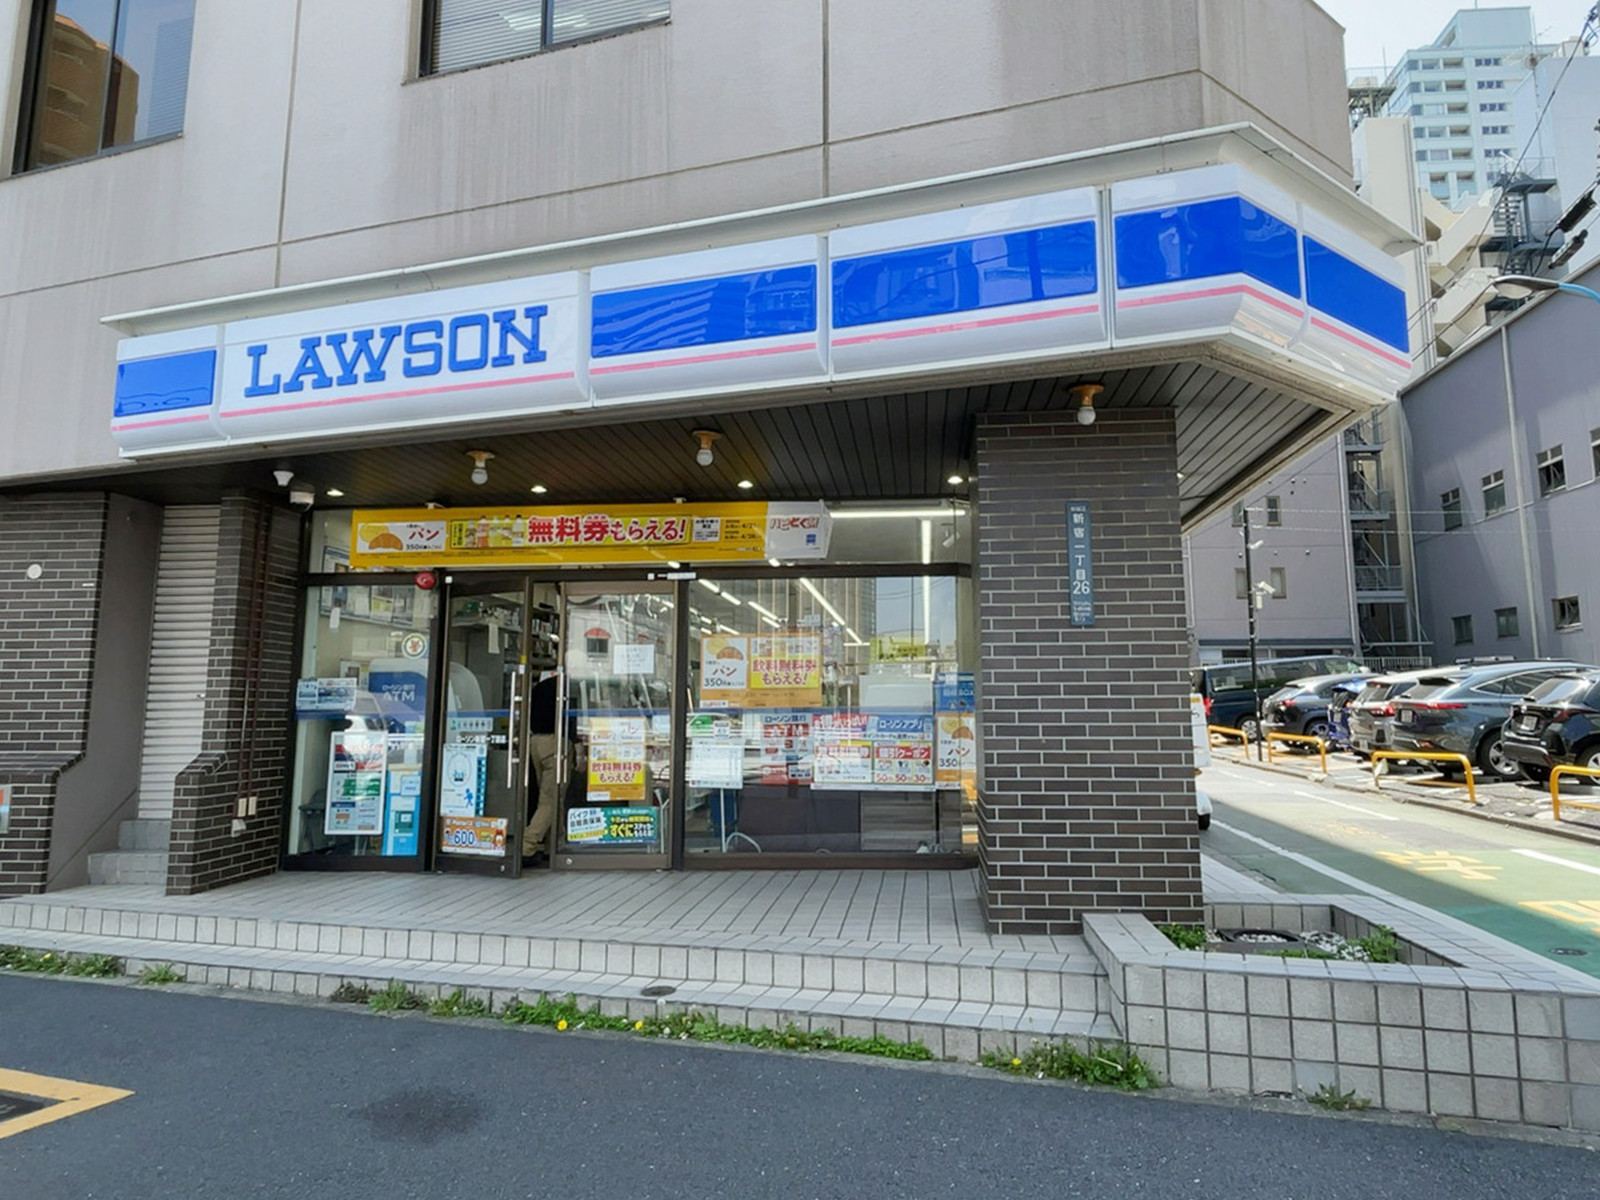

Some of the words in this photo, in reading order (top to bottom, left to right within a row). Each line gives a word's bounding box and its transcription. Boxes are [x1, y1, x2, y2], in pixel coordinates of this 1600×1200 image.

[244, 304, 549, 398] LAWSON
[408, 528, 440, 541] パン
[762, 673, 809, 685] もらえる!
[383, 691, 415, 702] ATM
[771, 724, 803, 736] ATM
[453, 829, 476, 846] 600
